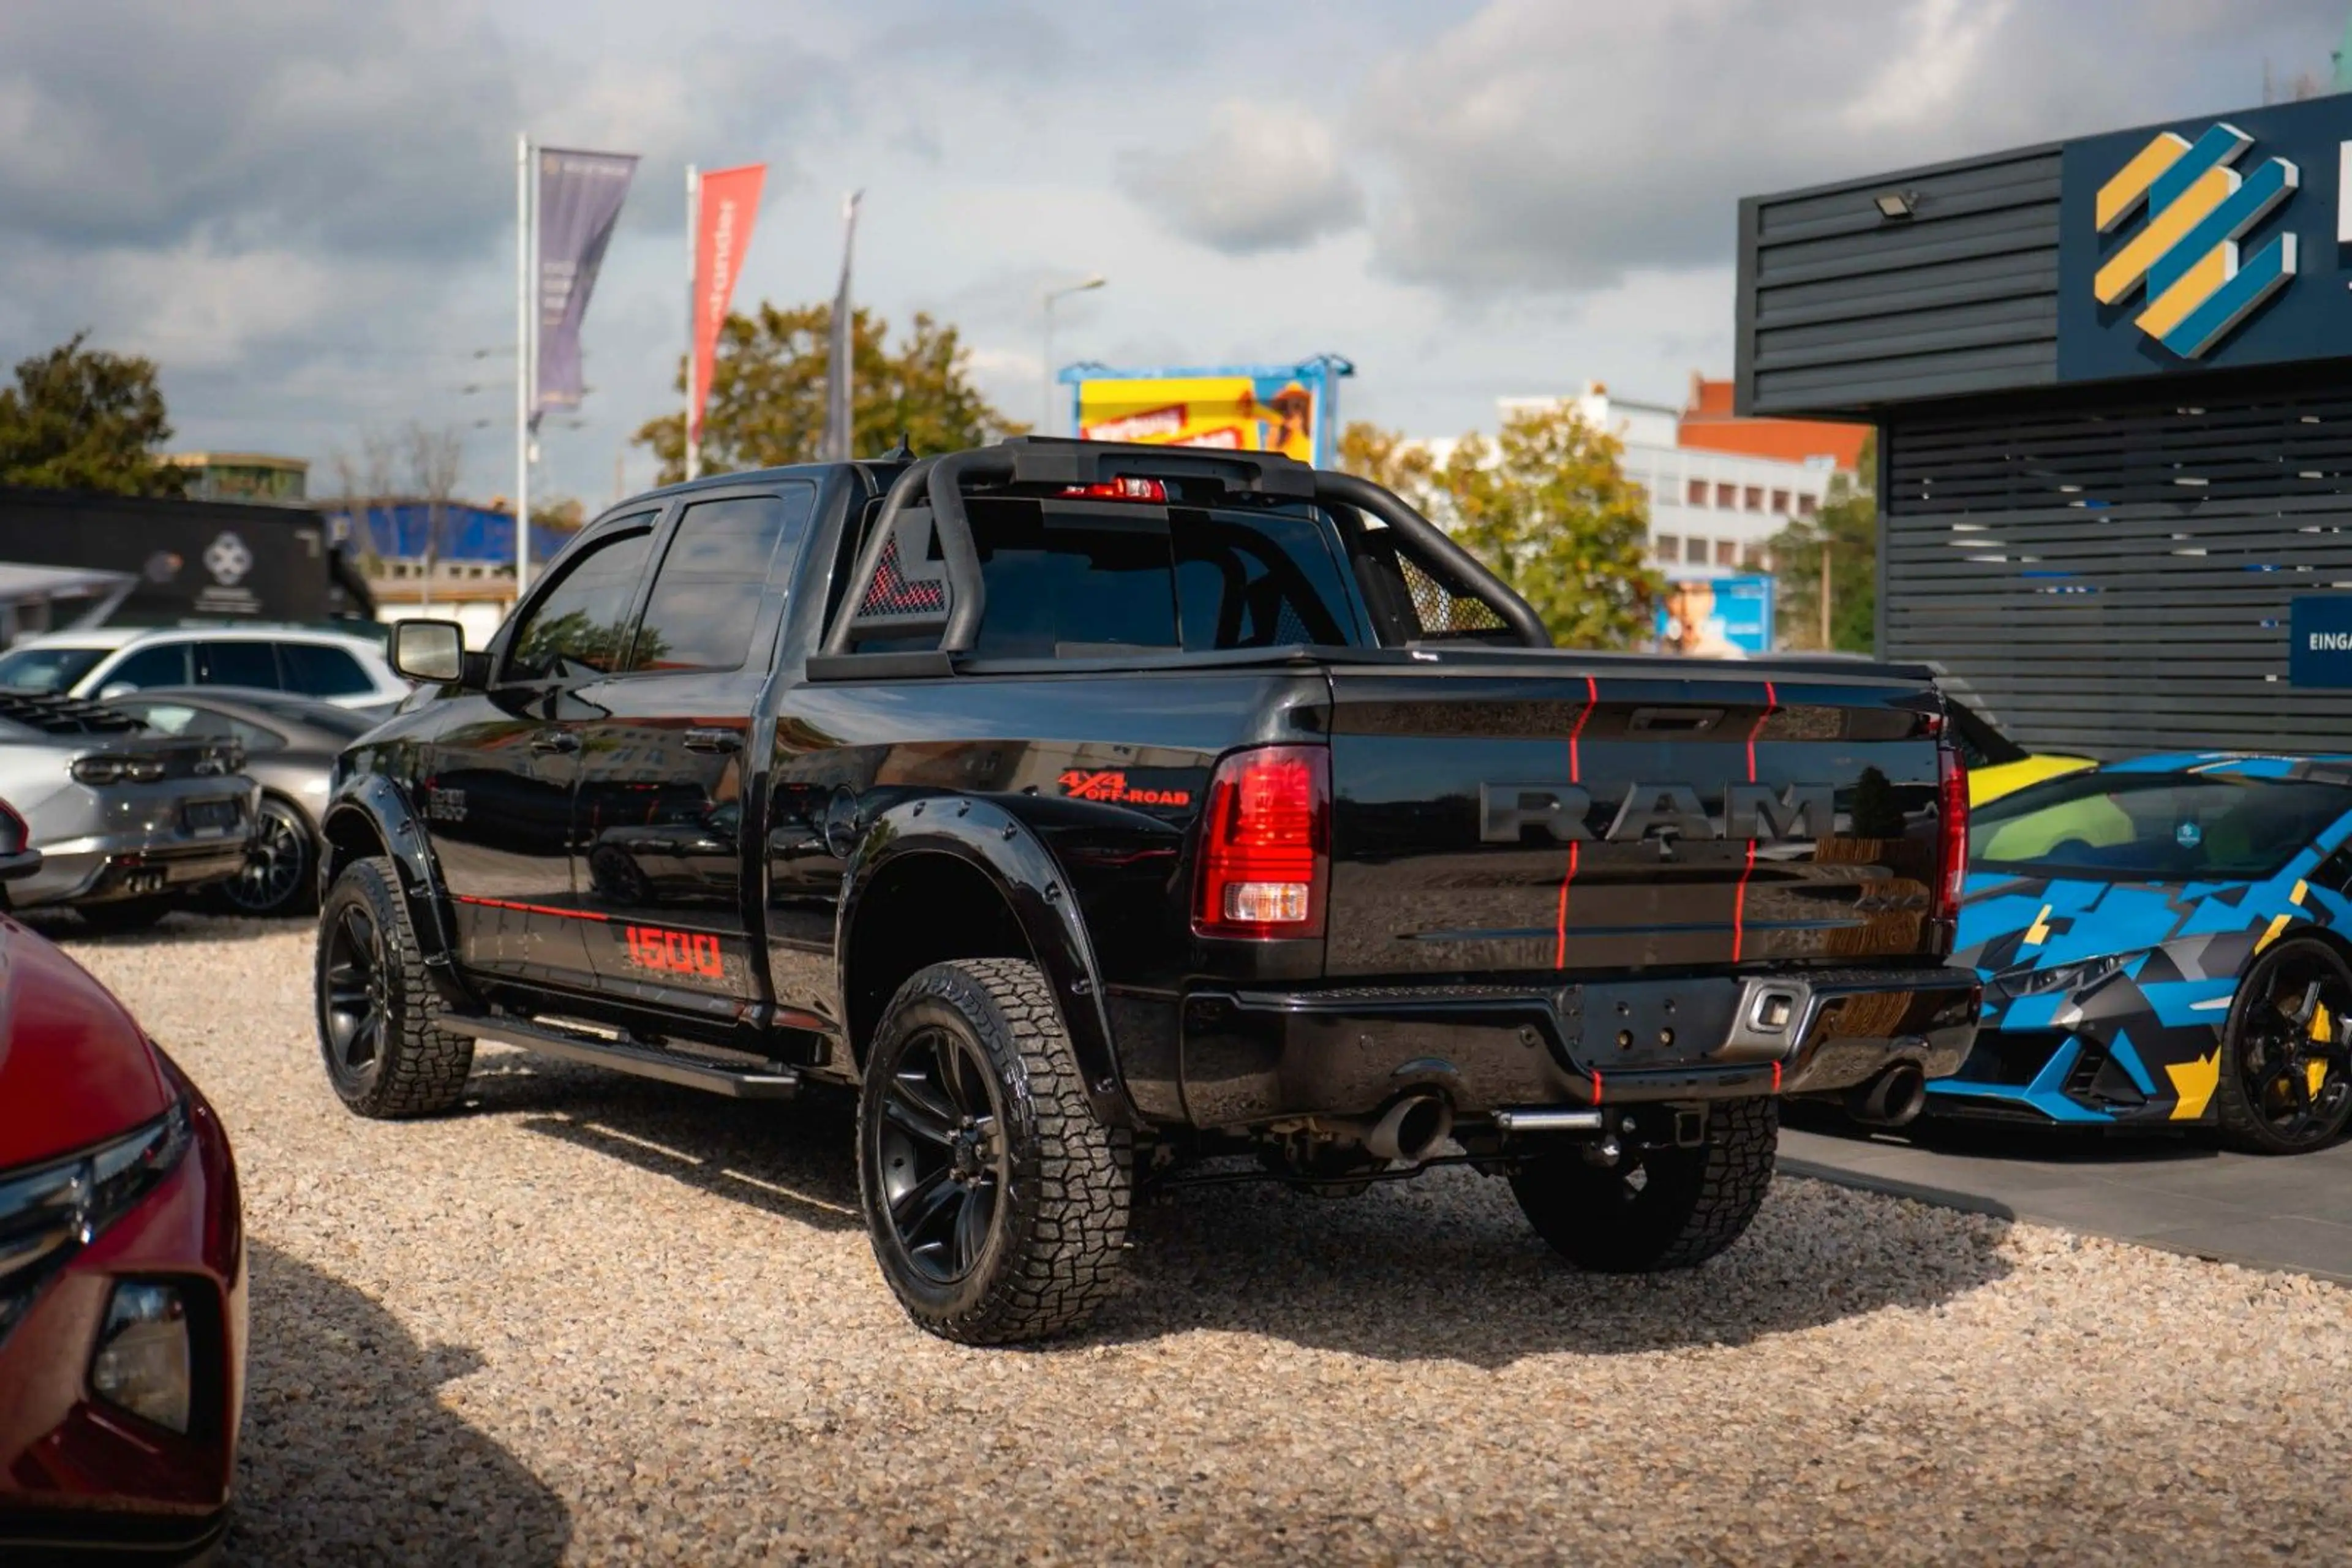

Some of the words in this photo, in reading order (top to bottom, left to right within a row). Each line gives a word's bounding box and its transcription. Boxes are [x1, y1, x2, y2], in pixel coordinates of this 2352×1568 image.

[1085, 789, 1190, 806] OFF-ROAD
[1480, 782, 1834, 842] RAM
[626, 925, 725, 978] 1500
